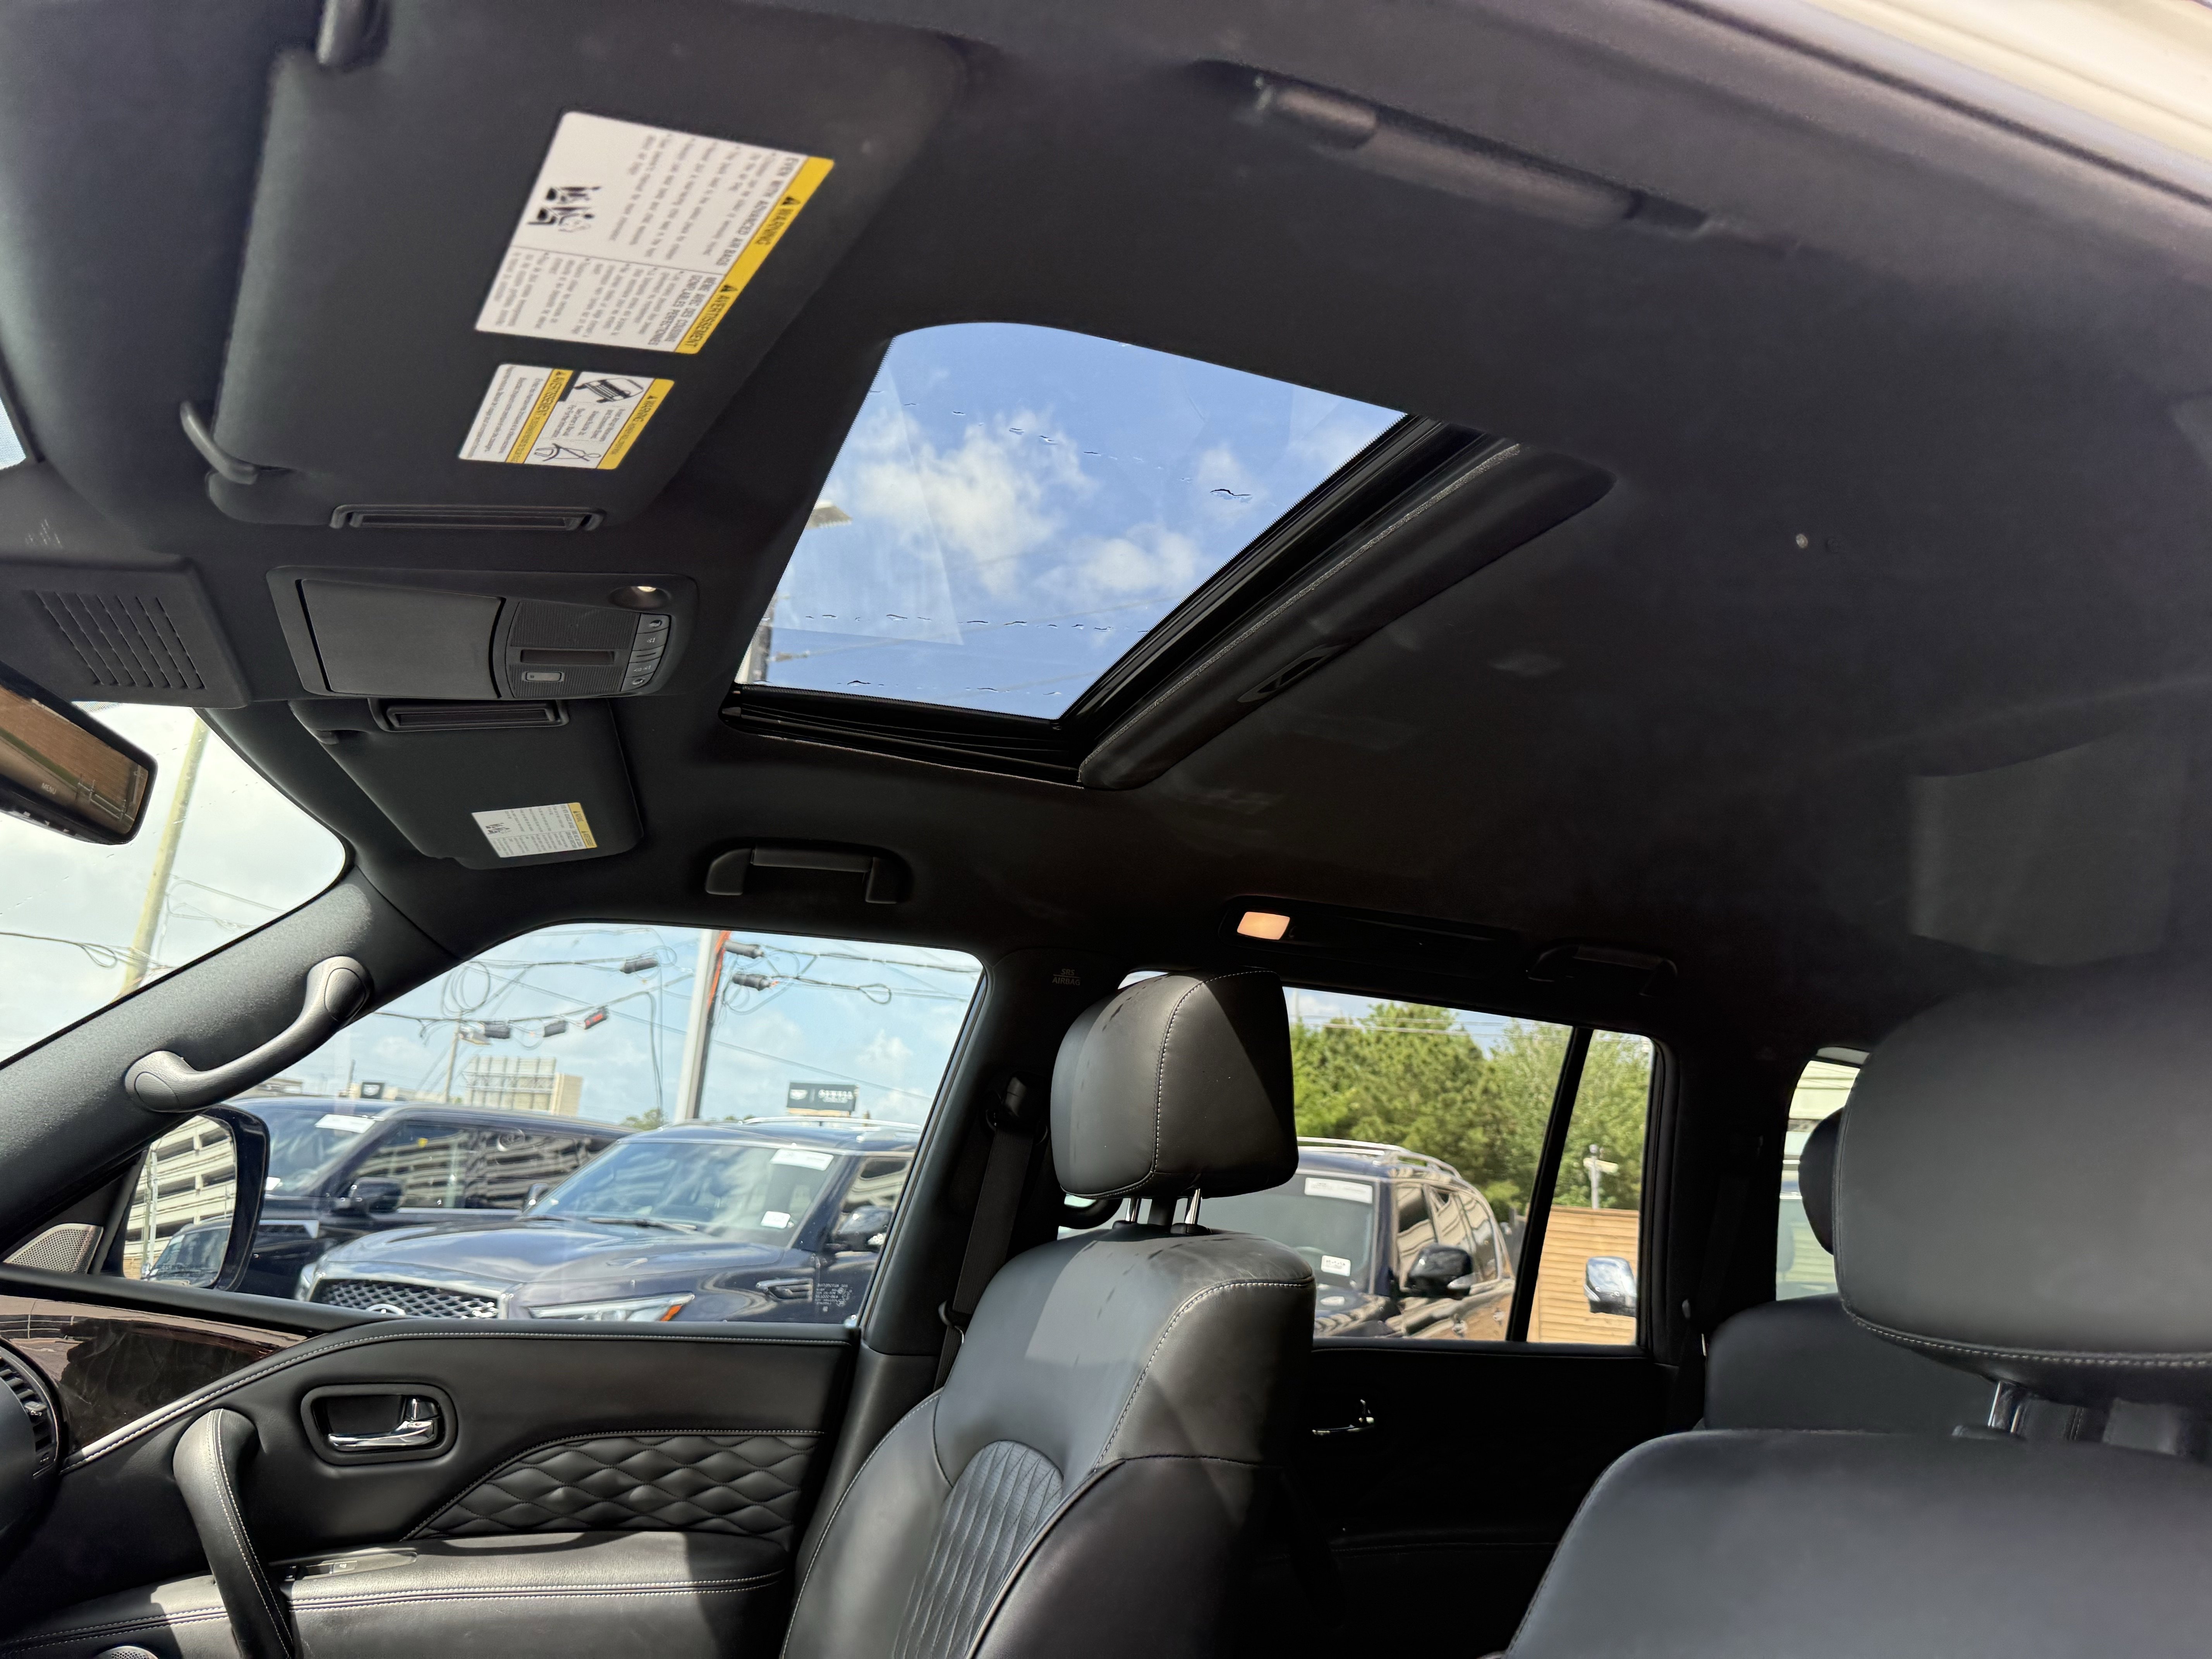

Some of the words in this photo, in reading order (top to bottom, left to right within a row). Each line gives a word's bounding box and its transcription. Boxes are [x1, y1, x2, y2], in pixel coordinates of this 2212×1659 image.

[776, 156, 800, 177] EVEN
[763, 180, 784, 198] WITH
[736, 200, 769, 235] ADVANCED
[755, 208, 793, 246] WARNING
[728, 237, 744, 248] AIR
[714, 249, 736, 266] BAGS
[688, 294, 706, 306] AVEC
[680, 308, 696, 318] DES
[683, 295, 731, 347] AVERTISSEMENT
[41, 783, 57, 795] MENU
[1052, 977, 1080, 986] AIRBAG
